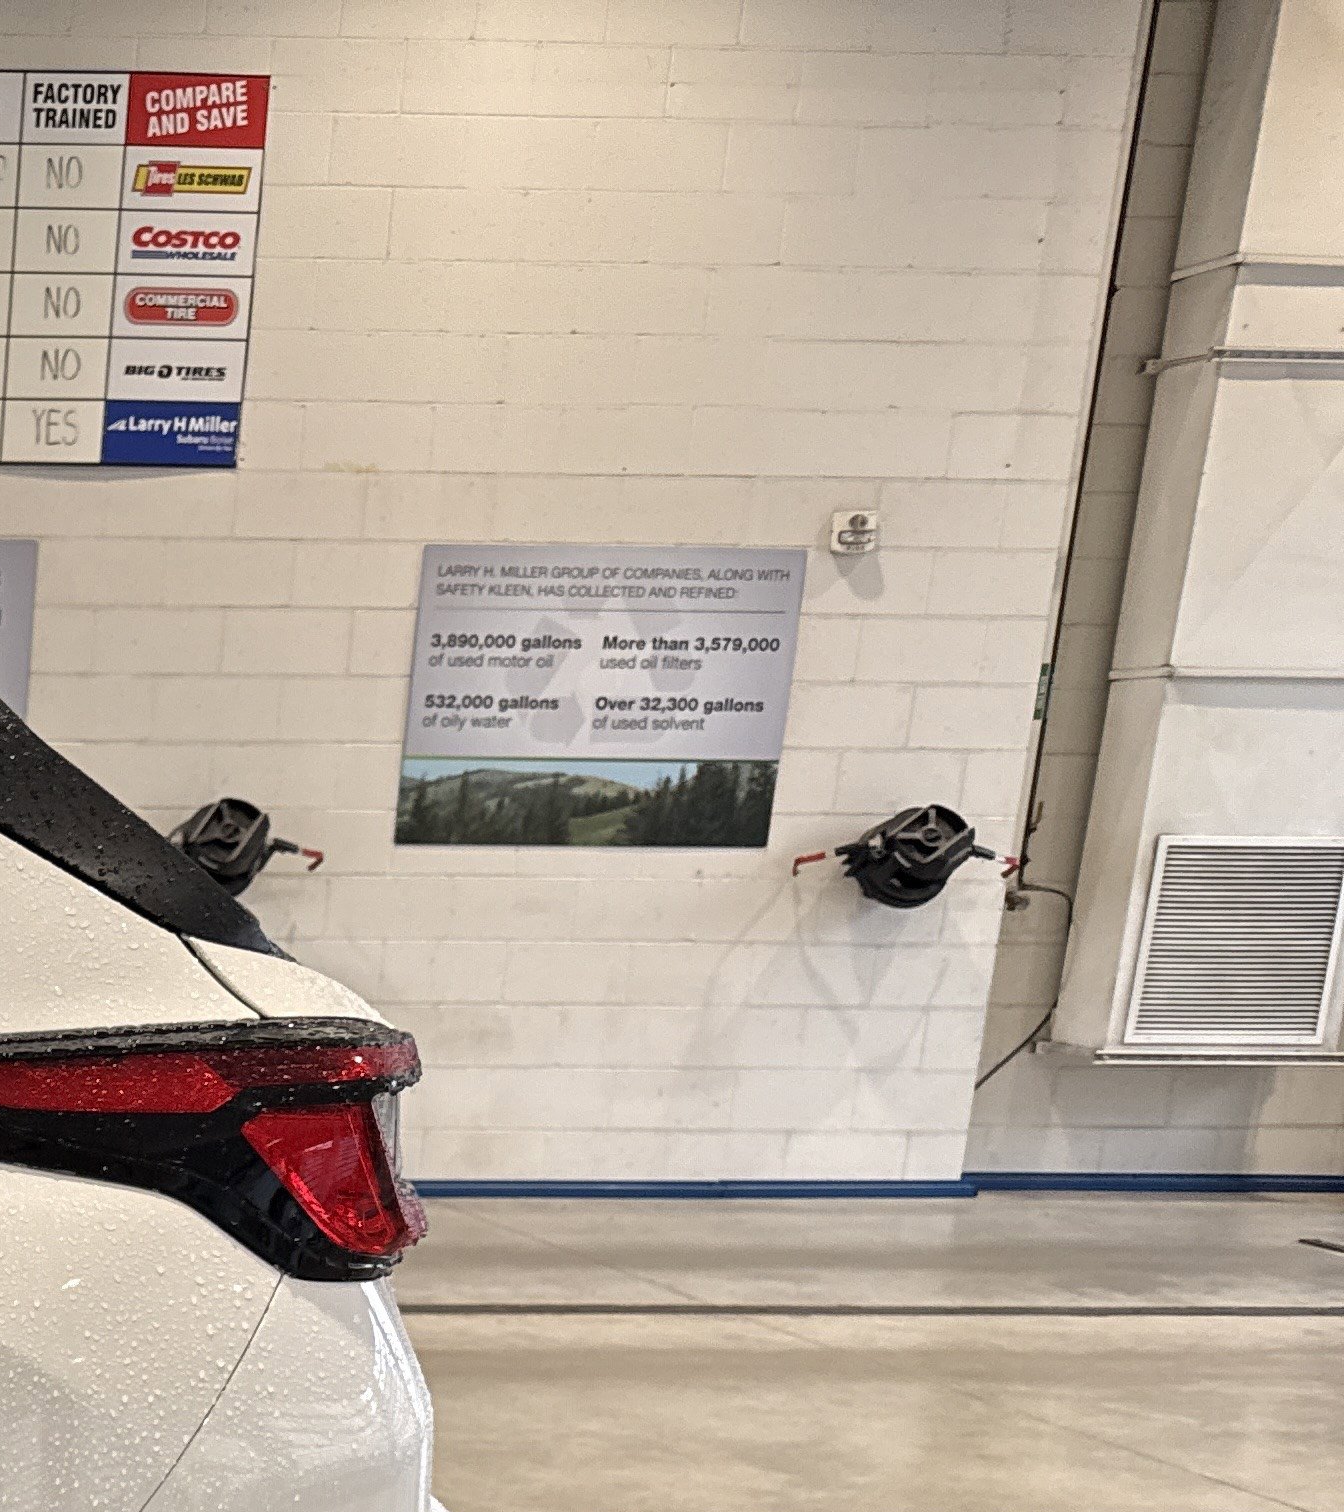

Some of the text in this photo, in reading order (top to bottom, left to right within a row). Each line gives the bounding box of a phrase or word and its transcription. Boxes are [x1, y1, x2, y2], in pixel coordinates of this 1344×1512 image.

[33, 83, 121, 105] FACTORY
[145, 80, 248, 113] COMPARE
[33, 107, 116, 130] TRAINED
[147, 105, 248, 138] AND SAVE
[45, 156, 83, 189] NO
[45, 224, 79, 255] NO
[132, 226, 241, 249] COSTCO
[43, 286, 81, 319] NO
[135, 293, 228, 308] COMMERCIAL
[165, 307, 197, 320] TIRE
[40, 348, 80, 381] NO
[124, 365, 154, 377] BIG
[175, 366, 226, 380] TIRES
[31, 409, 79, 446] YES
[129, 416, 238, 435] Larry H Miller
[438, 565, 480, 577] LARRY
[500, 565, 547, 578] MILLER
[551, 566, 599, 579] GROUP
[602, 566, 621, 580] OF
[707, 568, 753, 581] ALONG
[757, 569, 791, 581] WITH
[436, 583, 484, 596] SAFETY
[538, 585, 564, 597] HAS
[568, 585, 645, 598] COLLECTED
[648, 586, 676, 598] AND
[430, 633, 582, 652] 3,890,000 gallons
[602, 635, 780, 654] More than 3,579,000
[428, 654, 555, 668] of used motor oil
[599, 656, 703, 671] used oil filters
[424, 694, 560, 712] 532,000 gallons
[595, 697, 764, 715] Over 32,300 gallons
[422, 713, 512, 731] of oily water
[591, 715, 705, 730] of used solvent
